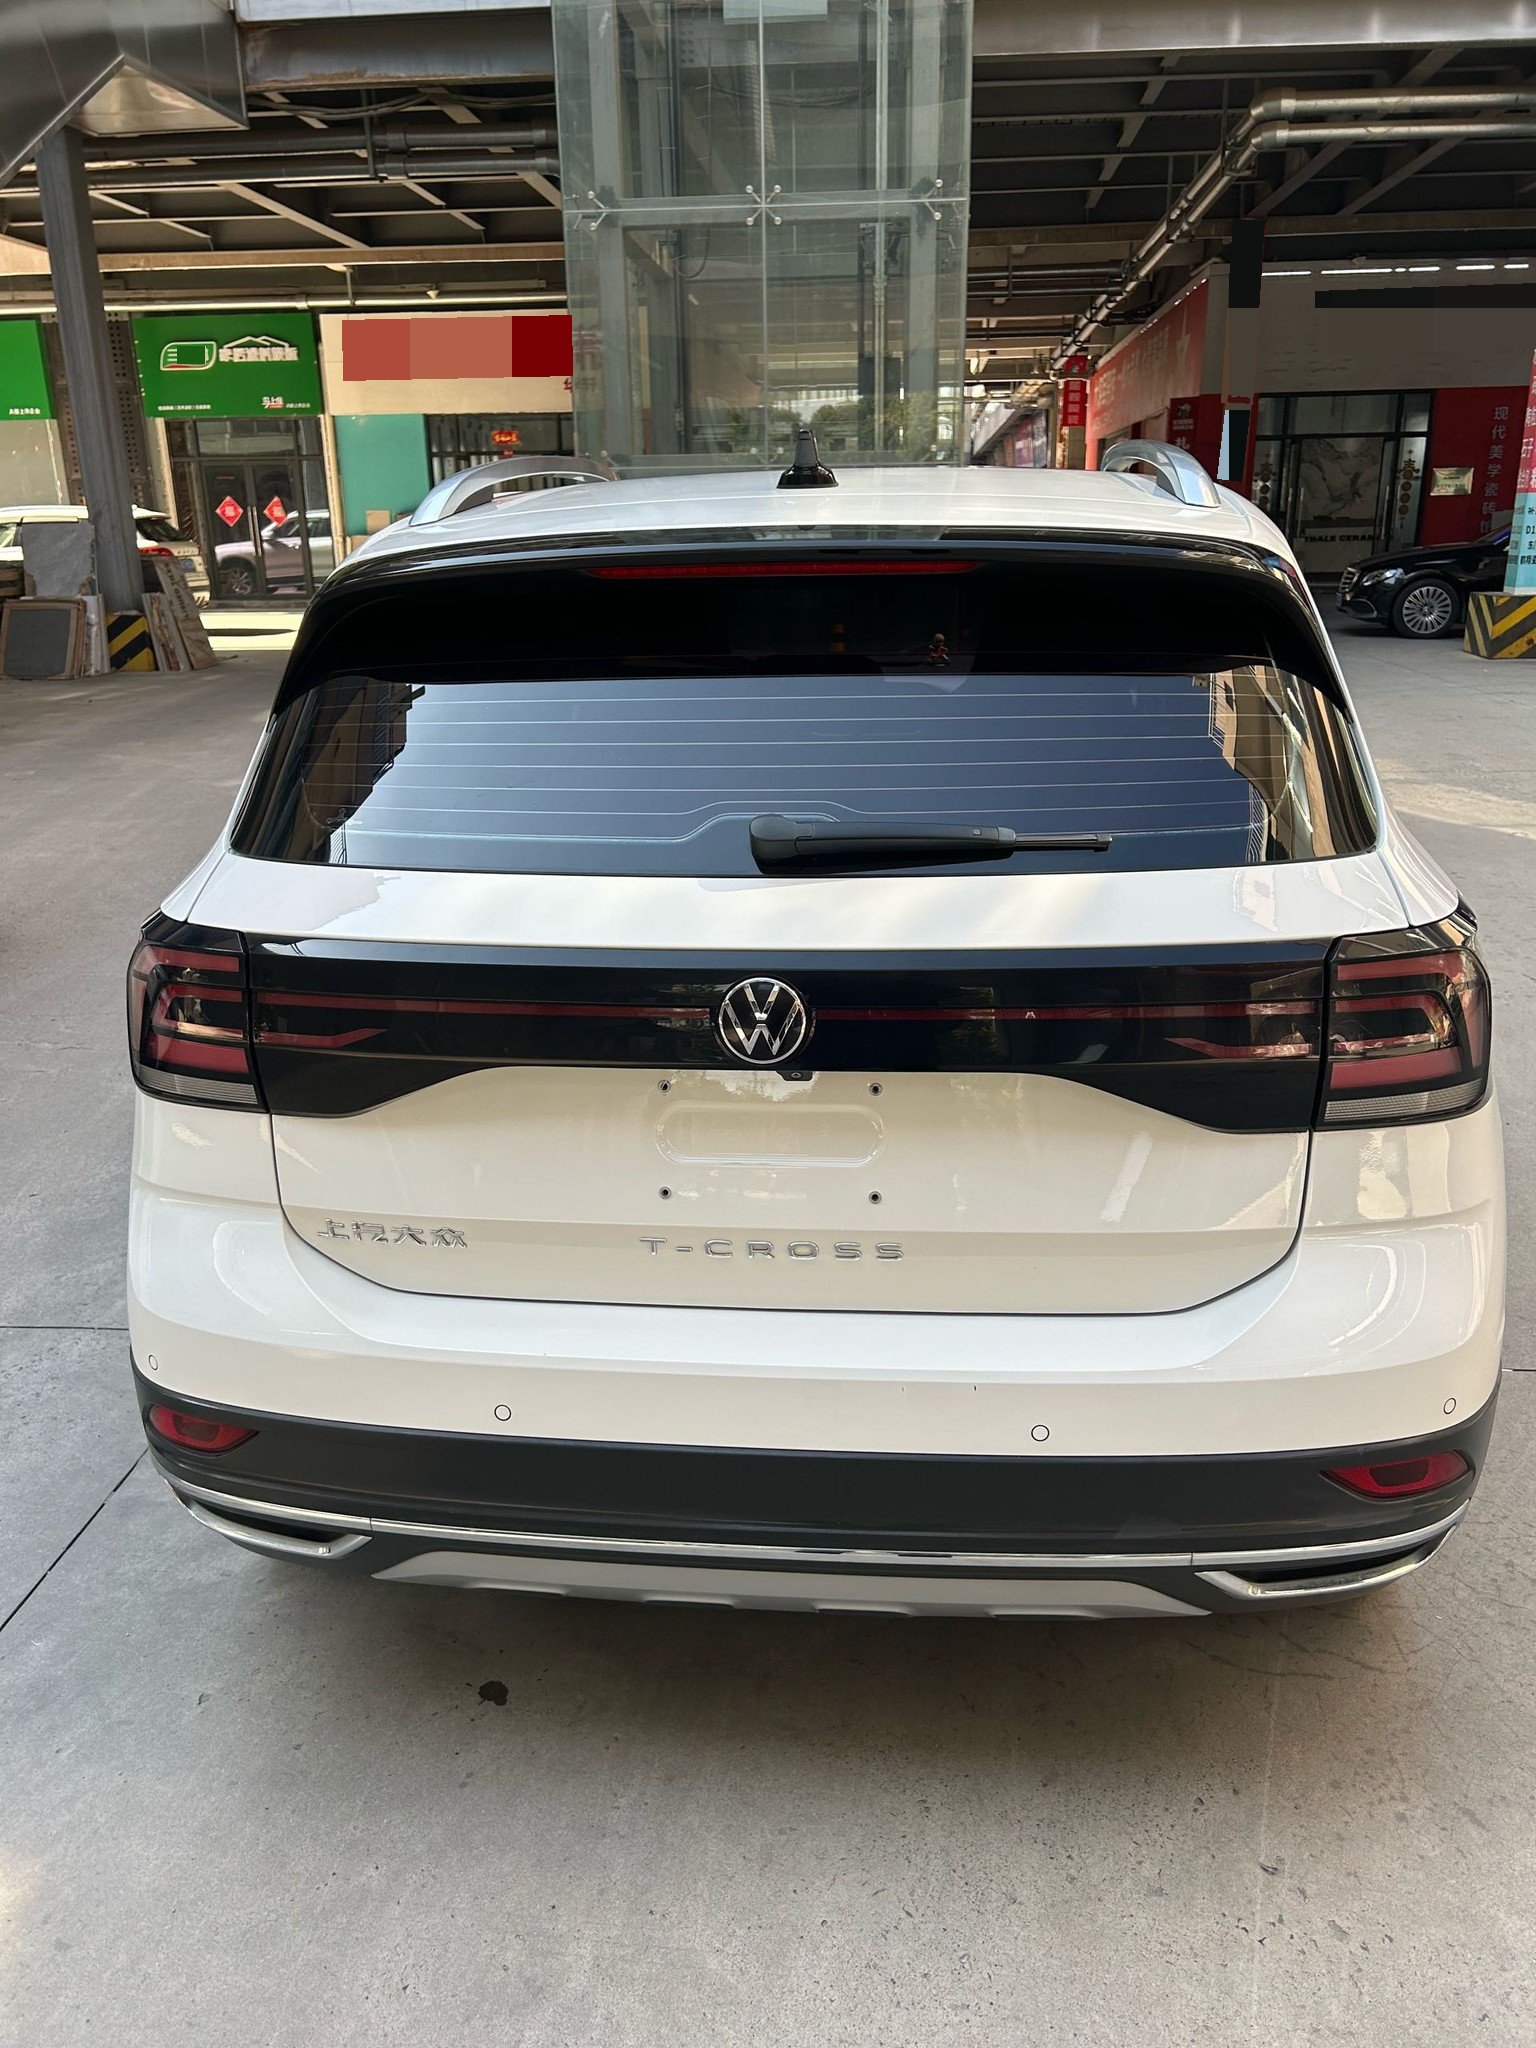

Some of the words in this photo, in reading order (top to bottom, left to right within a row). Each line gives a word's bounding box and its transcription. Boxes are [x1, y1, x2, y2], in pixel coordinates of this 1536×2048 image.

[317, 1217, 468, 1248] 上汽大众
[639, 1236, 904, 1261] T-CROSS
